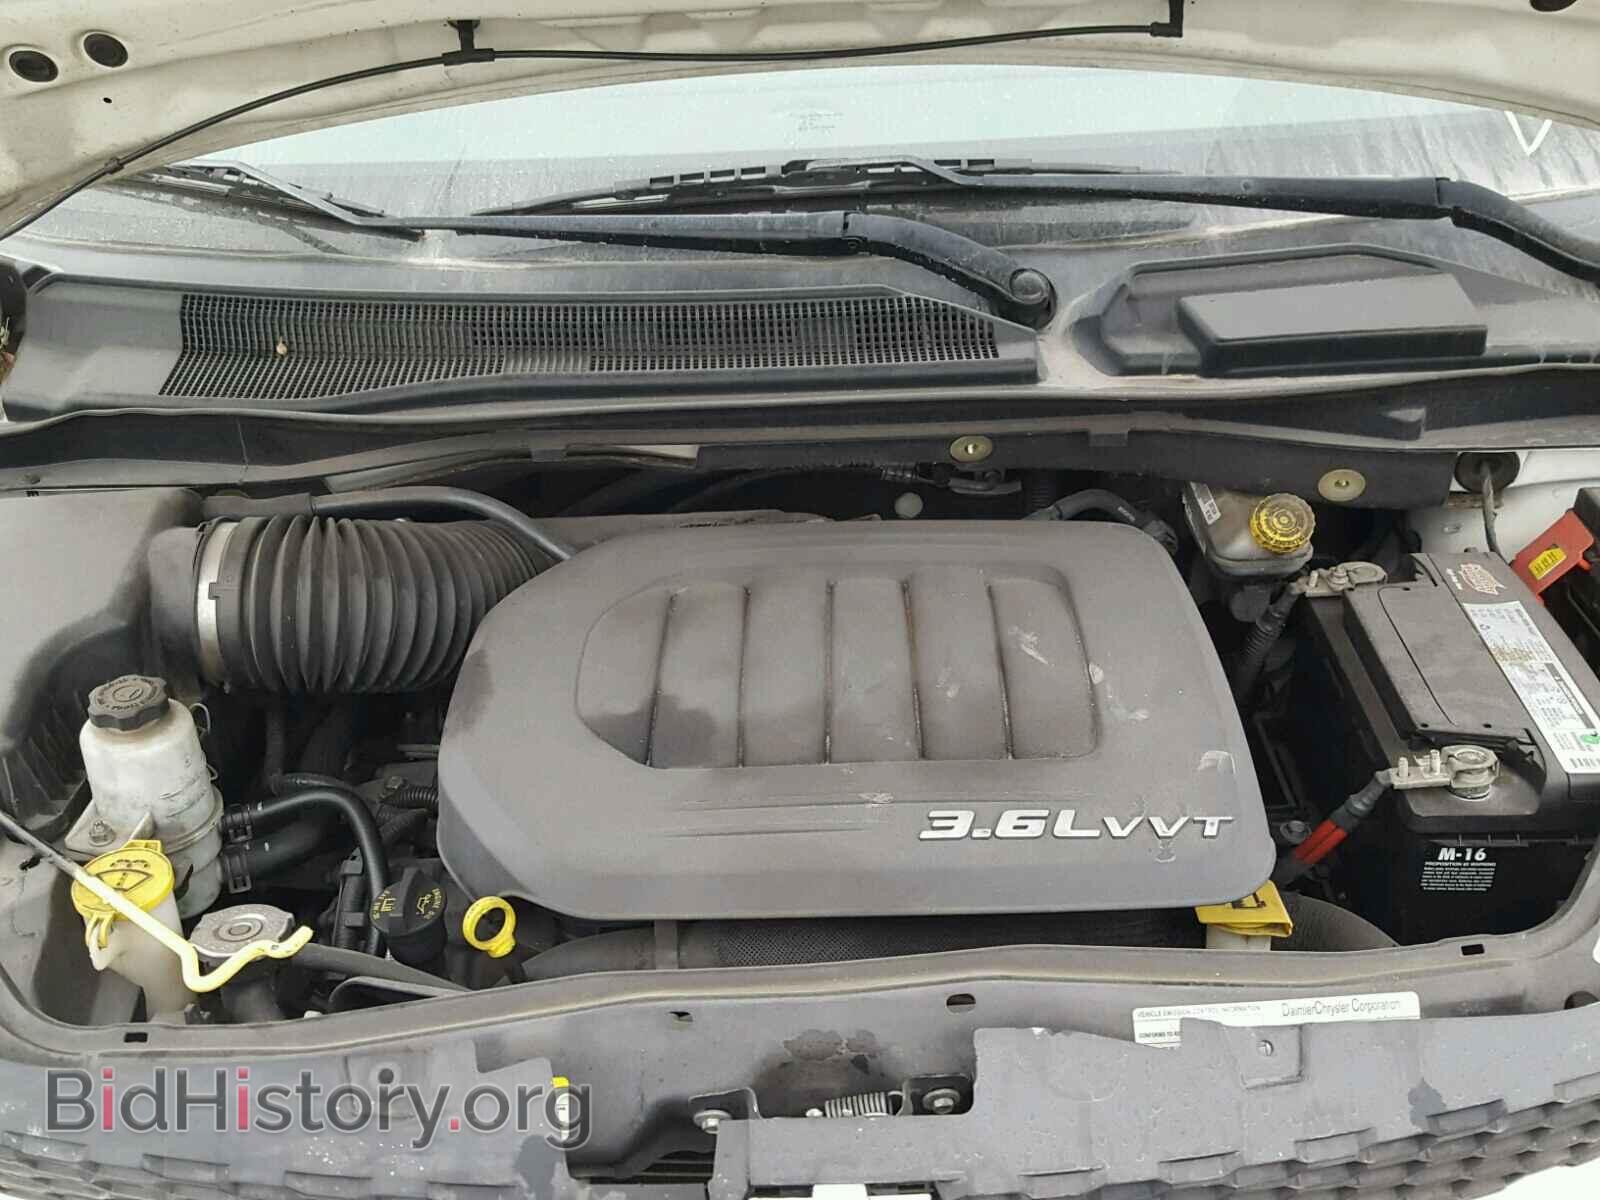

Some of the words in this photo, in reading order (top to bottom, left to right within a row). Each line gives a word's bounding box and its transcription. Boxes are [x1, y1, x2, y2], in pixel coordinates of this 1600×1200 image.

[1437, 847, 1487, 861] M-16
[1281, 999, 1350, 1017] DaimlerChrysler
[1351, 997, 1401, 1014] Corporation
